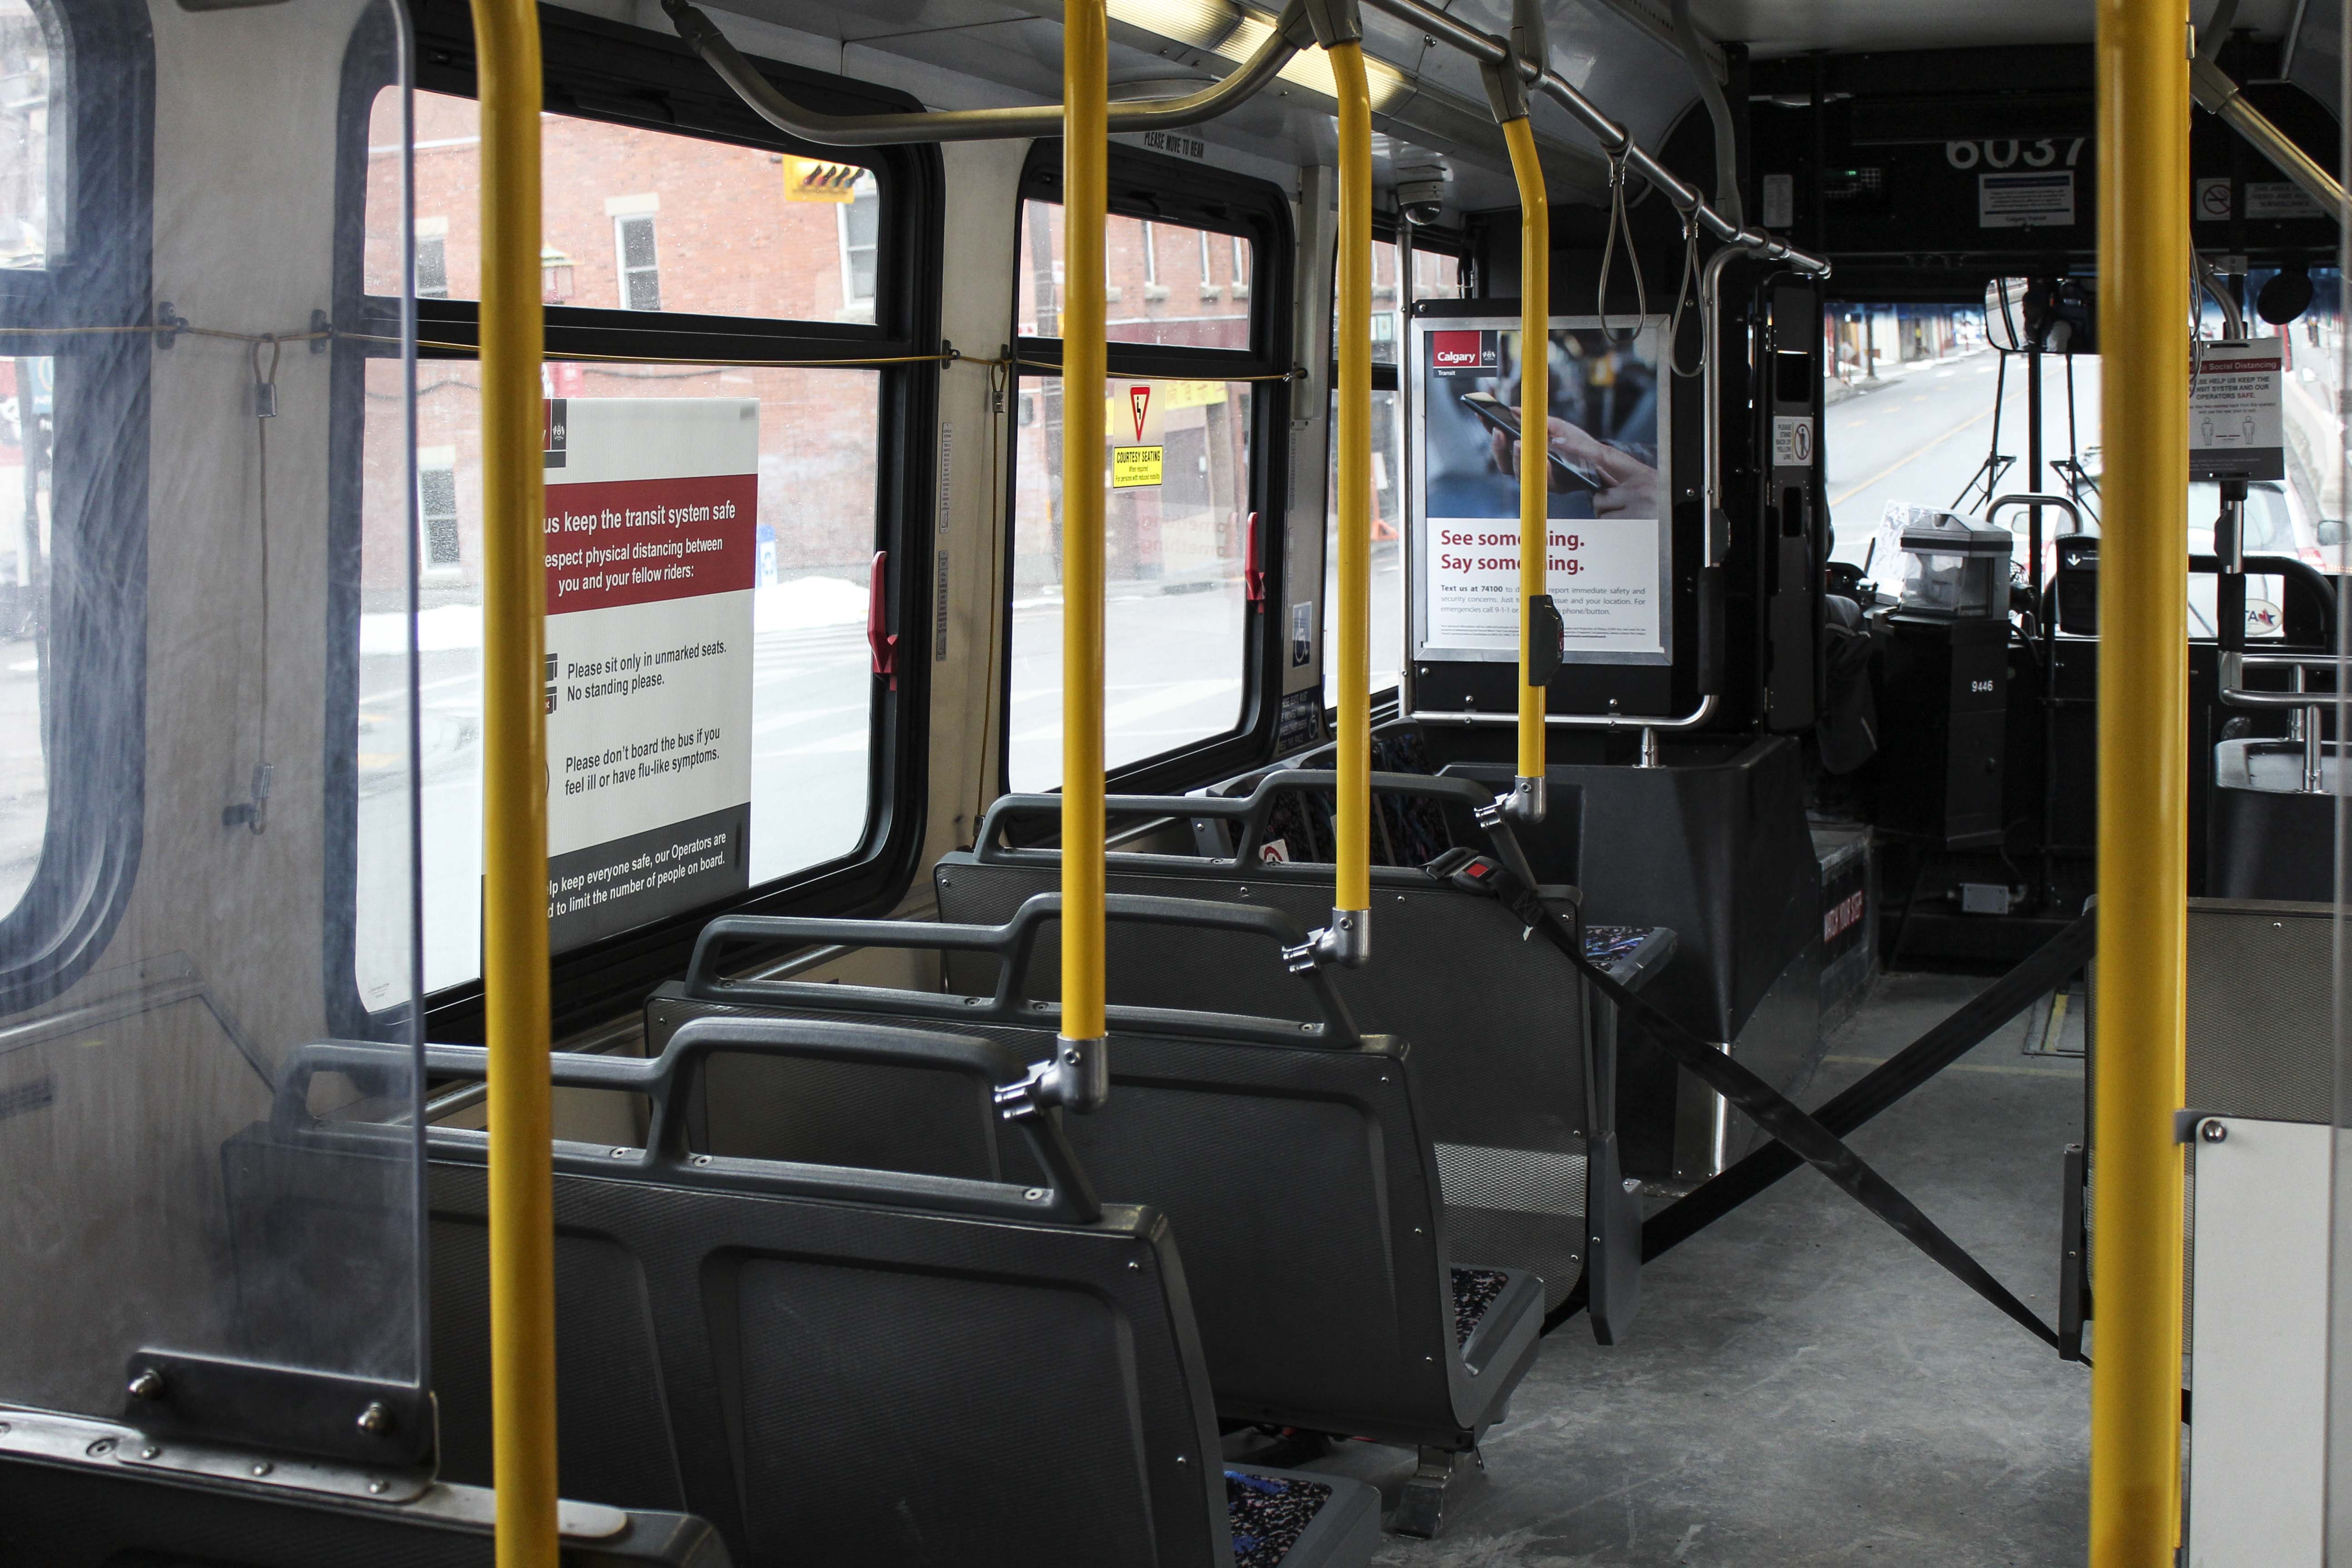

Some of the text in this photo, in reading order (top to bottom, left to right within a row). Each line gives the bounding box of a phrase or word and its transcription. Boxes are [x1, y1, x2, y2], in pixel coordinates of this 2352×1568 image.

[1144, 132, 1204, 158] PLEASE MOVE TO REAR
[1437, 351, 1475, 363] Calgary
[2209, 361, 2233, 371] Social
[2234, 361, 2277, 371] Distancing
[1117, 451, 1160, 463] COURTESY SEATING
[543, 500, 735, 535] us keep the transit system safe
[543, 538, 723, 570] espect physical distancing between
[1441, 530, 1584, 551] See soming.
[1441, 554, 1584, 575] Say soming.
[558, 564, 694, 597] you and your fellow riders:
[568, 640, 726, 680] Please sit only in unmarked seats.
[567, 673, 665, 701] No standing please.
[1972, 681, 1993, 692] 9446
[566, 727, 720, 773] Please don't board the bus if you
[565, 748, 720, 796] feel ill or have flu-like symptoms.
[561, 875, 584, 890] keep
[587, 862, 629, 884] everyone
[632, 853, 652, 871] safe,
[655, 850, 670, 863] our
[672, 838, 711, 860] Operators
[714, 833, 726, 846] are
[557, 902, 567, 916] to
[569, 893, 590, 912] limit
[593, 889, 608, 905] the
[610, 879, 645, 899] number
[647, 872, 656, 887] of
[658, 864, 686, 888] people
[688, 862, 698, 874] on
[701, 851, 725, 871] board.
